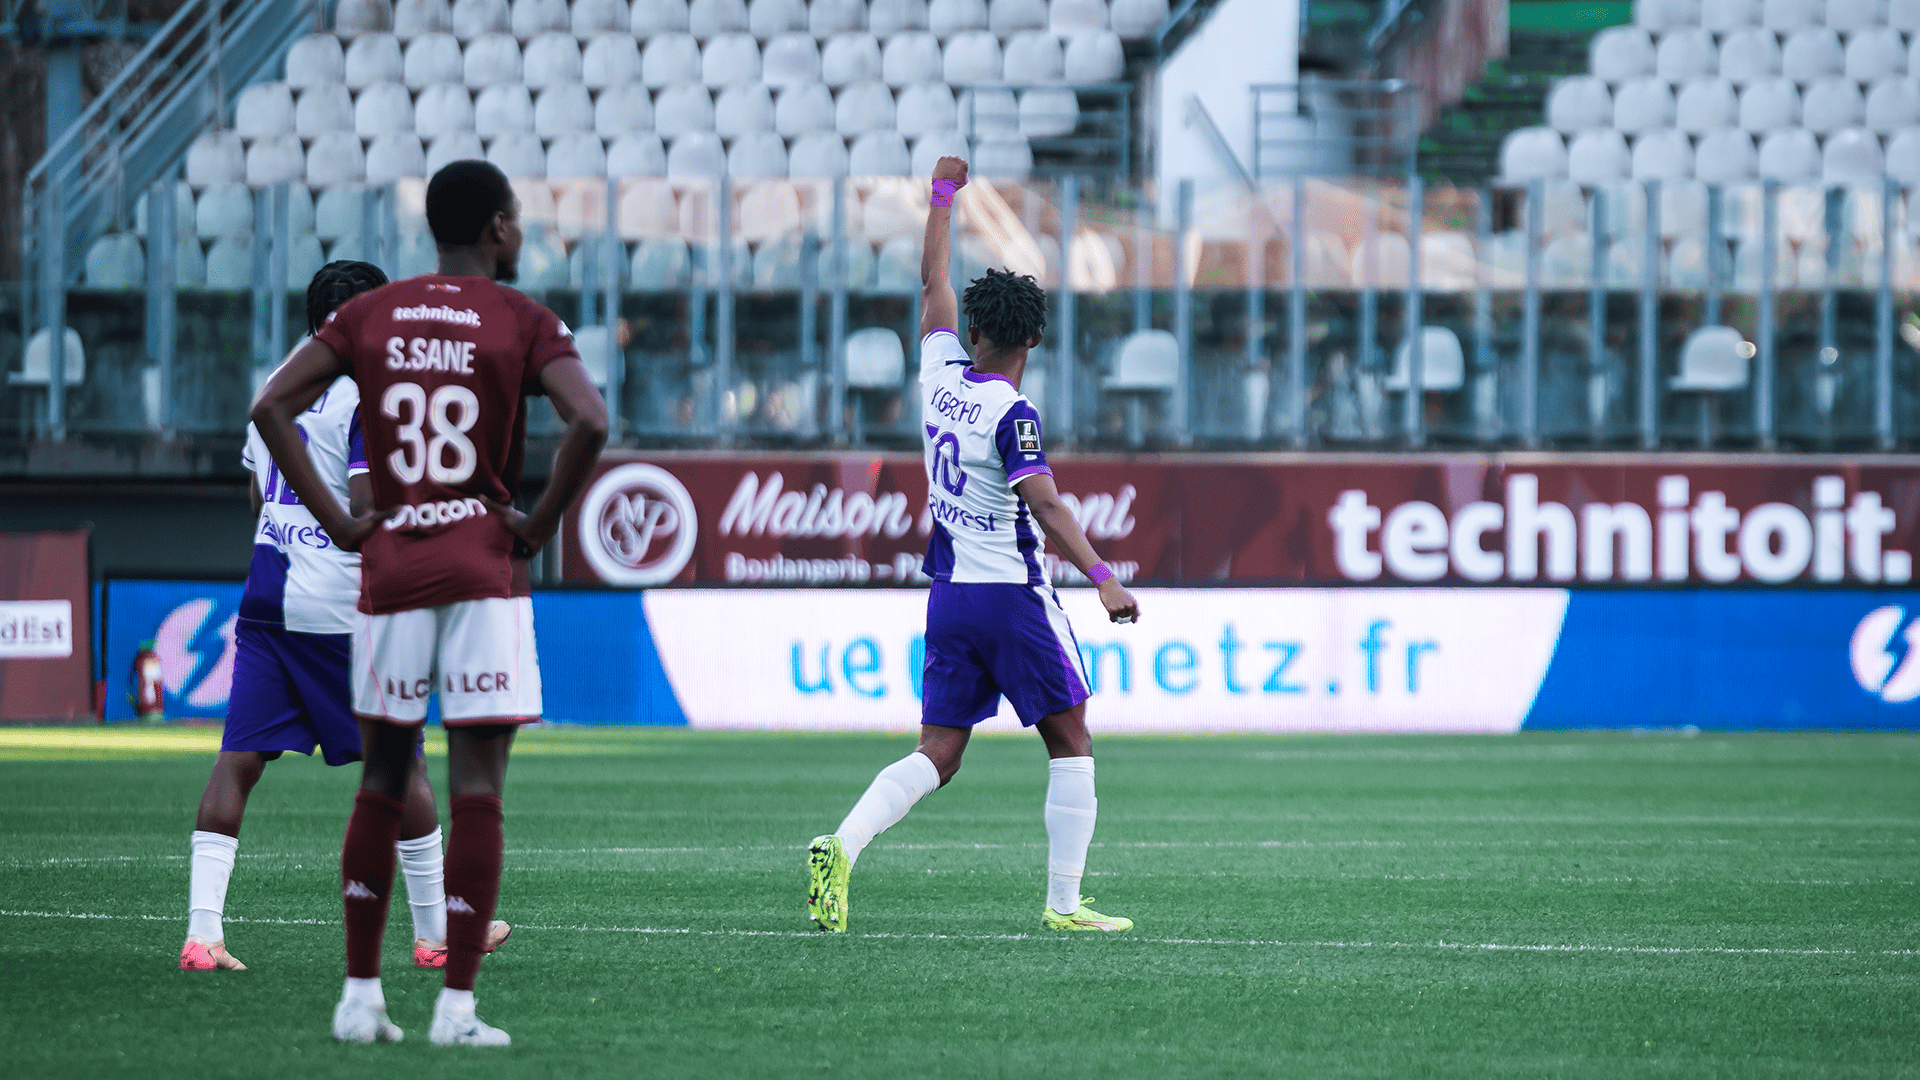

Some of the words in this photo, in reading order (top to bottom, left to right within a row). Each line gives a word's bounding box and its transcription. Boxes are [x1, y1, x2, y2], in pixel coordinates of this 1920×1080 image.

[392, 304, 482, 329] technitoit.
[385, 336, 478, 377] S.SANE
[381, 381, 480, 486] 38
[718, 470, 914, 538] Maison
[1327, 472, 1913, 583] technitoit.
[724, 551, 872, 585] Boulangerie
[399, 677, 433, 700] LC
